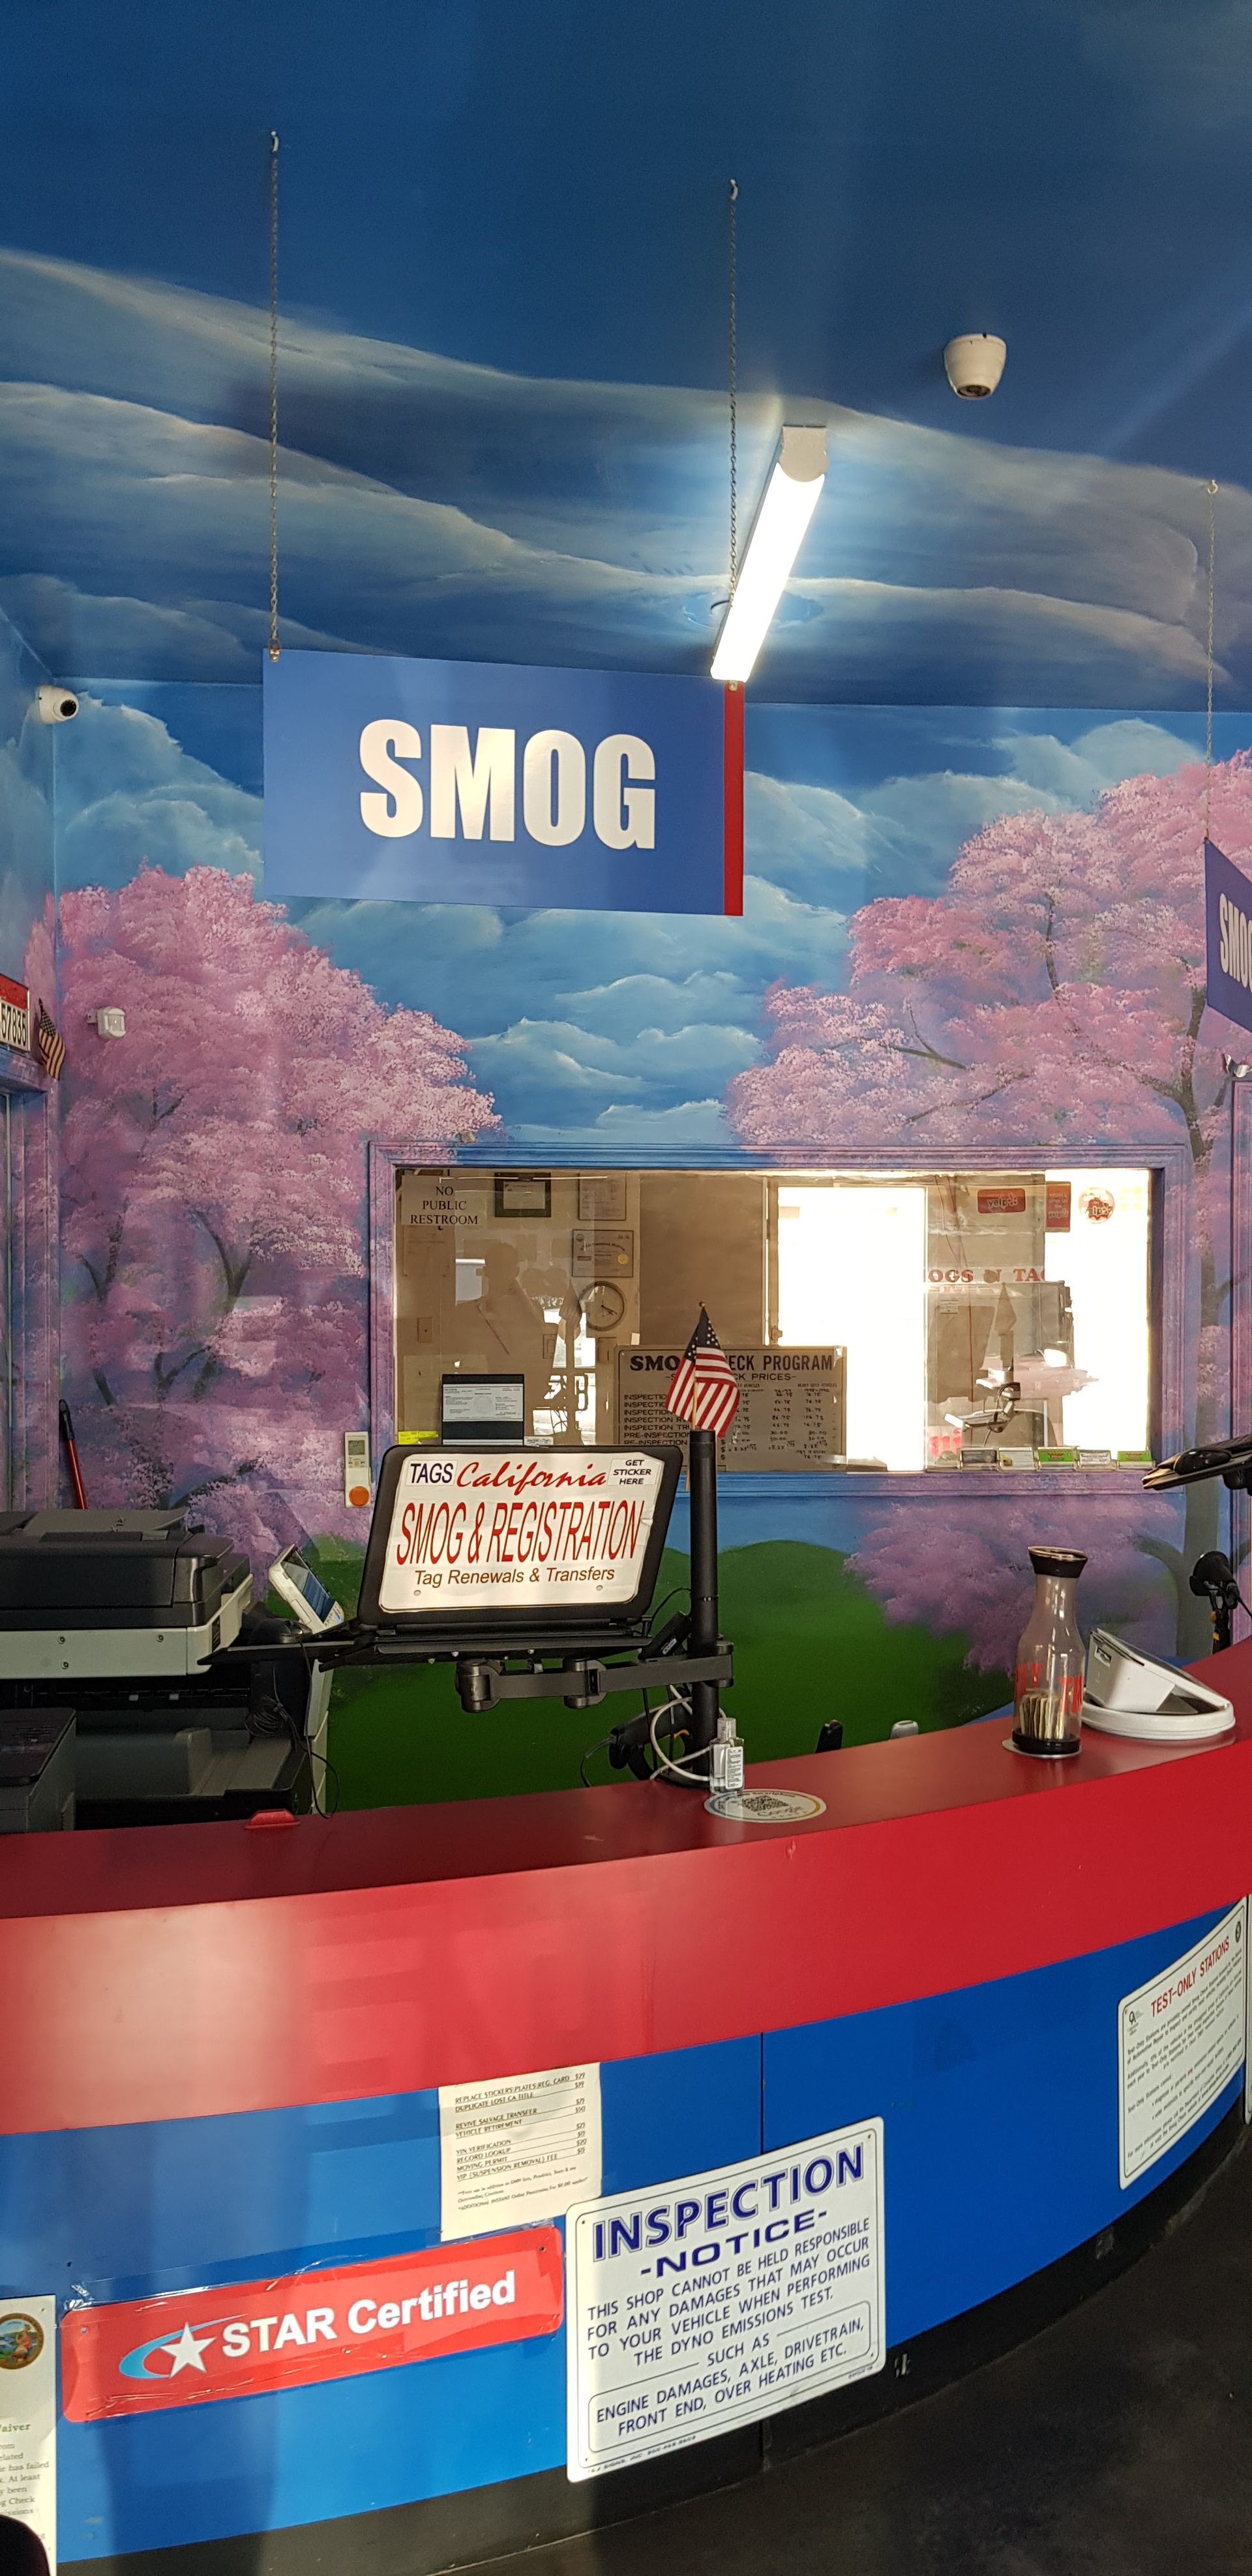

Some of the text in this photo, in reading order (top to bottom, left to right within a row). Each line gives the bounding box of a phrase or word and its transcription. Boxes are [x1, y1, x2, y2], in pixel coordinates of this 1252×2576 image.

[359, 719, 655, 849] SMOG
[1, 1003, 26, 1047] 57835
[423, 1201, 466, 1210] PUBLIC
[436, 1186, 453, 1196] NO
[987, 1199, 1009, 1209] yelp
[410, 1215, 478, 1225] RESTROOM
[630, 1355, 832, 1371] SMO ECK PROGRAM
[410, 1463, 453, 1484] TAGS
[456, 1461, 608, 1496] California
[396, 1500, 645, 1565] SMOG & REGISTRATION
[415, 1566, 615, 1588] Tag Renewals & Transfers
[1151, 1935, 1230, 2018] TEST-ONLY STATIONS
[455, 2093, 481, 2104] REPLACE
[554, 2075, 570, 2084] CARD
[455, 2101, 488, 2112] DUPLICATE
[491, 2095, 505, 2105] LOST
[456, 2120, 477, 2130] REVIVE
[479, 2114, 503, 2125] SALVAGE
[507, 2108, 537, 2119] TRANSFER
[456, 2129, 481, 2138] VEHICLE
[484, 2119, 522, 2133] RETIREMENT
[456, 2153, 483, 2163] RECORD
[485, 2148, 511, 2159] LOOKUP
[469, 2138, 511, 2153] VERIFICATION
[547, 2153, 558, 2163] FEE
[457, 2162, 483, 2172] MOVING
[485, 2157, 507, 2166] PERMIT
[593, 2142, 864, 2262] INSPECTION
[641, 2208, 827, 2278] -NOTICE-
[588, 2217, 869, 2320] THIS SHOP CANNOT BE HELD RESPONSIBLE
[588, 2236, 869, 2341] FOR ANY DAMAGES THAT MAY OCCUR
[221, 2269, 515, 2358] STAR Certified
[588, 2254, 870, 2359] TO YOUR VEHICLE WHEN PERFORMING
[634, 2286, 833, 2366] THE DYNO EMISSIONS TEST.
[708, 2333, 769, 2367] SUCH AS
[597, 2317, 864, 2423] ENGINE DAMAGES, AXLE, DRIVETRAIN,
[618, 2343, 847, 2436] FRONT END, OVER HEATING ETC.
[27, 2461, 49, 2470] failed
